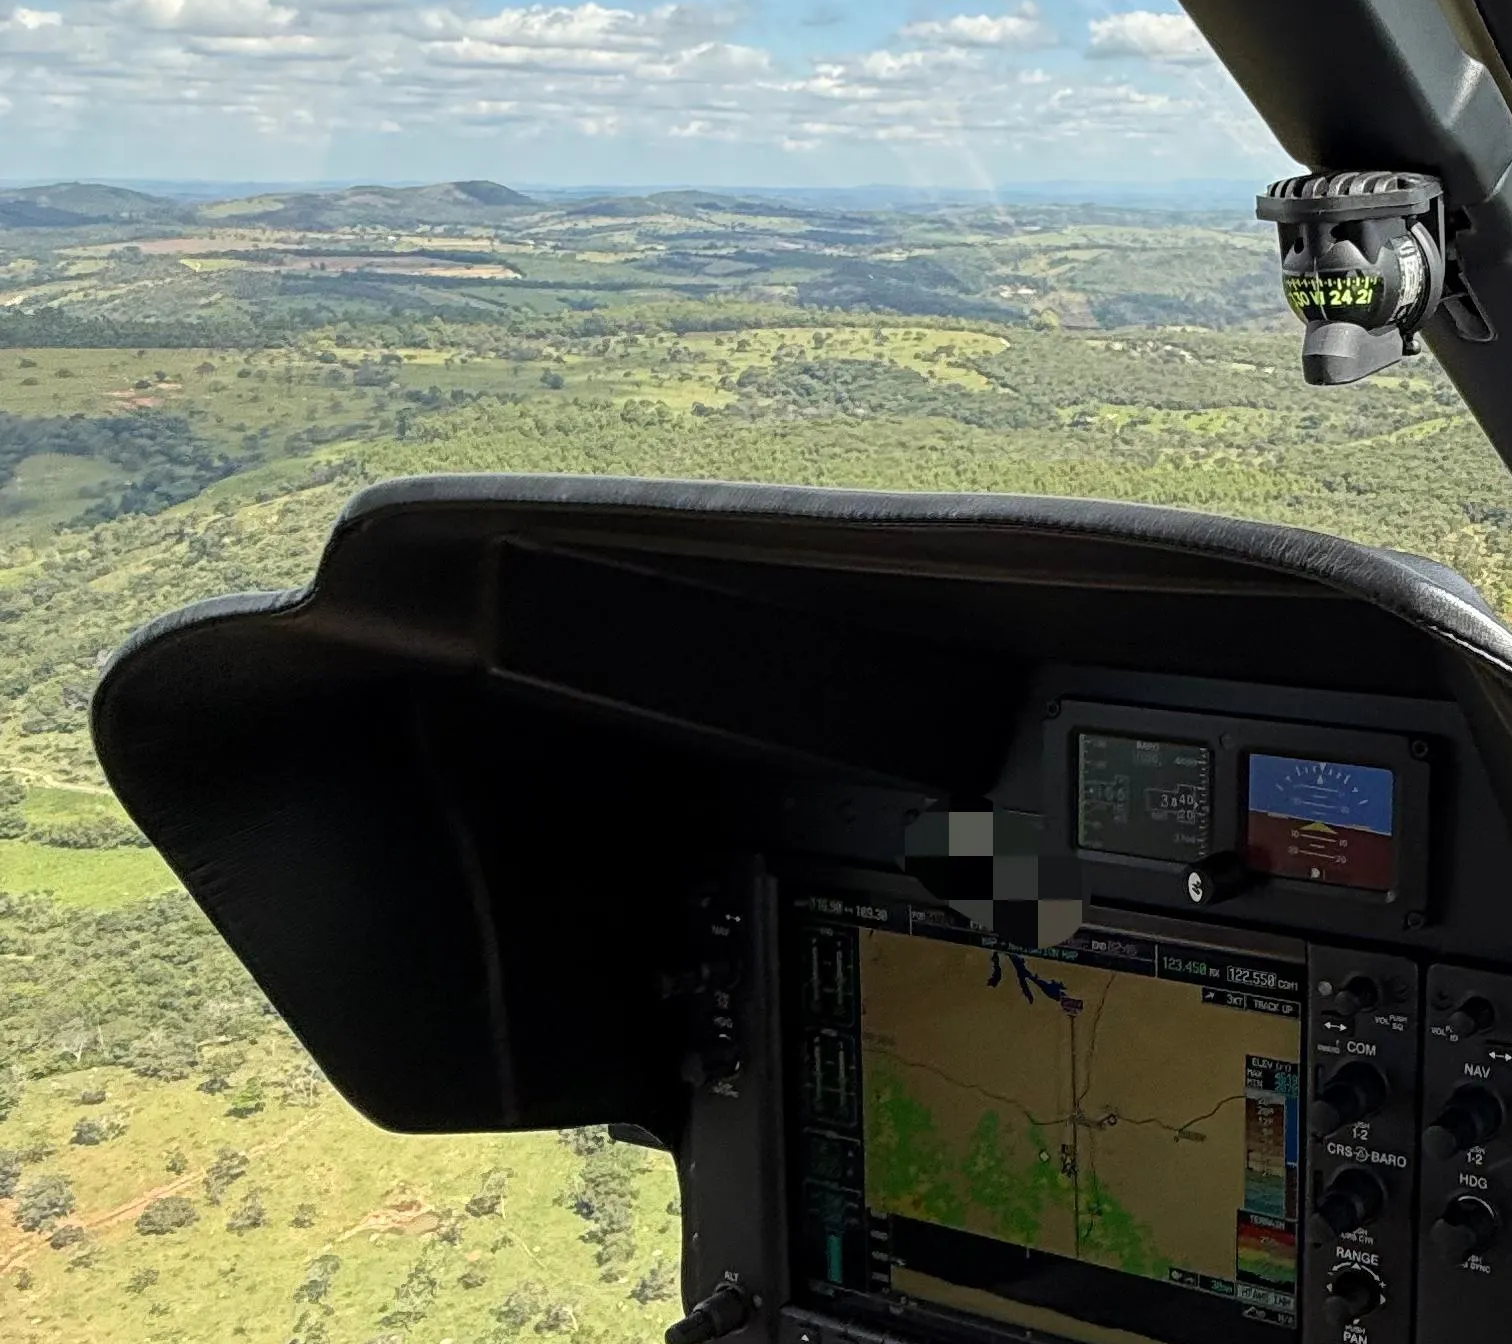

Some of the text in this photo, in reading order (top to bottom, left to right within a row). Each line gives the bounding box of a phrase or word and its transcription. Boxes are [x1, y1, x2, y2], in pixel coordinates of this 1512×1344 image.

[1330, 289, 1352, 305] 24
[1356, 289, 1373, 305] 21
[1162, 956, 1276, 987] 123.450 122.550
[1253, 998, 1293, 1014] TRACK UP
[1346, 1041, 1376, 1056] COM
[1464, 1062, 1490, 1078] NAV
[1327, 1143, 1352, 1157] CRS
[1371, 1150, 1407, 1168] BARO
[1458, 1173, 1488, 1190] HDG
[1336, 1246, 1379, 1267] RANGE
